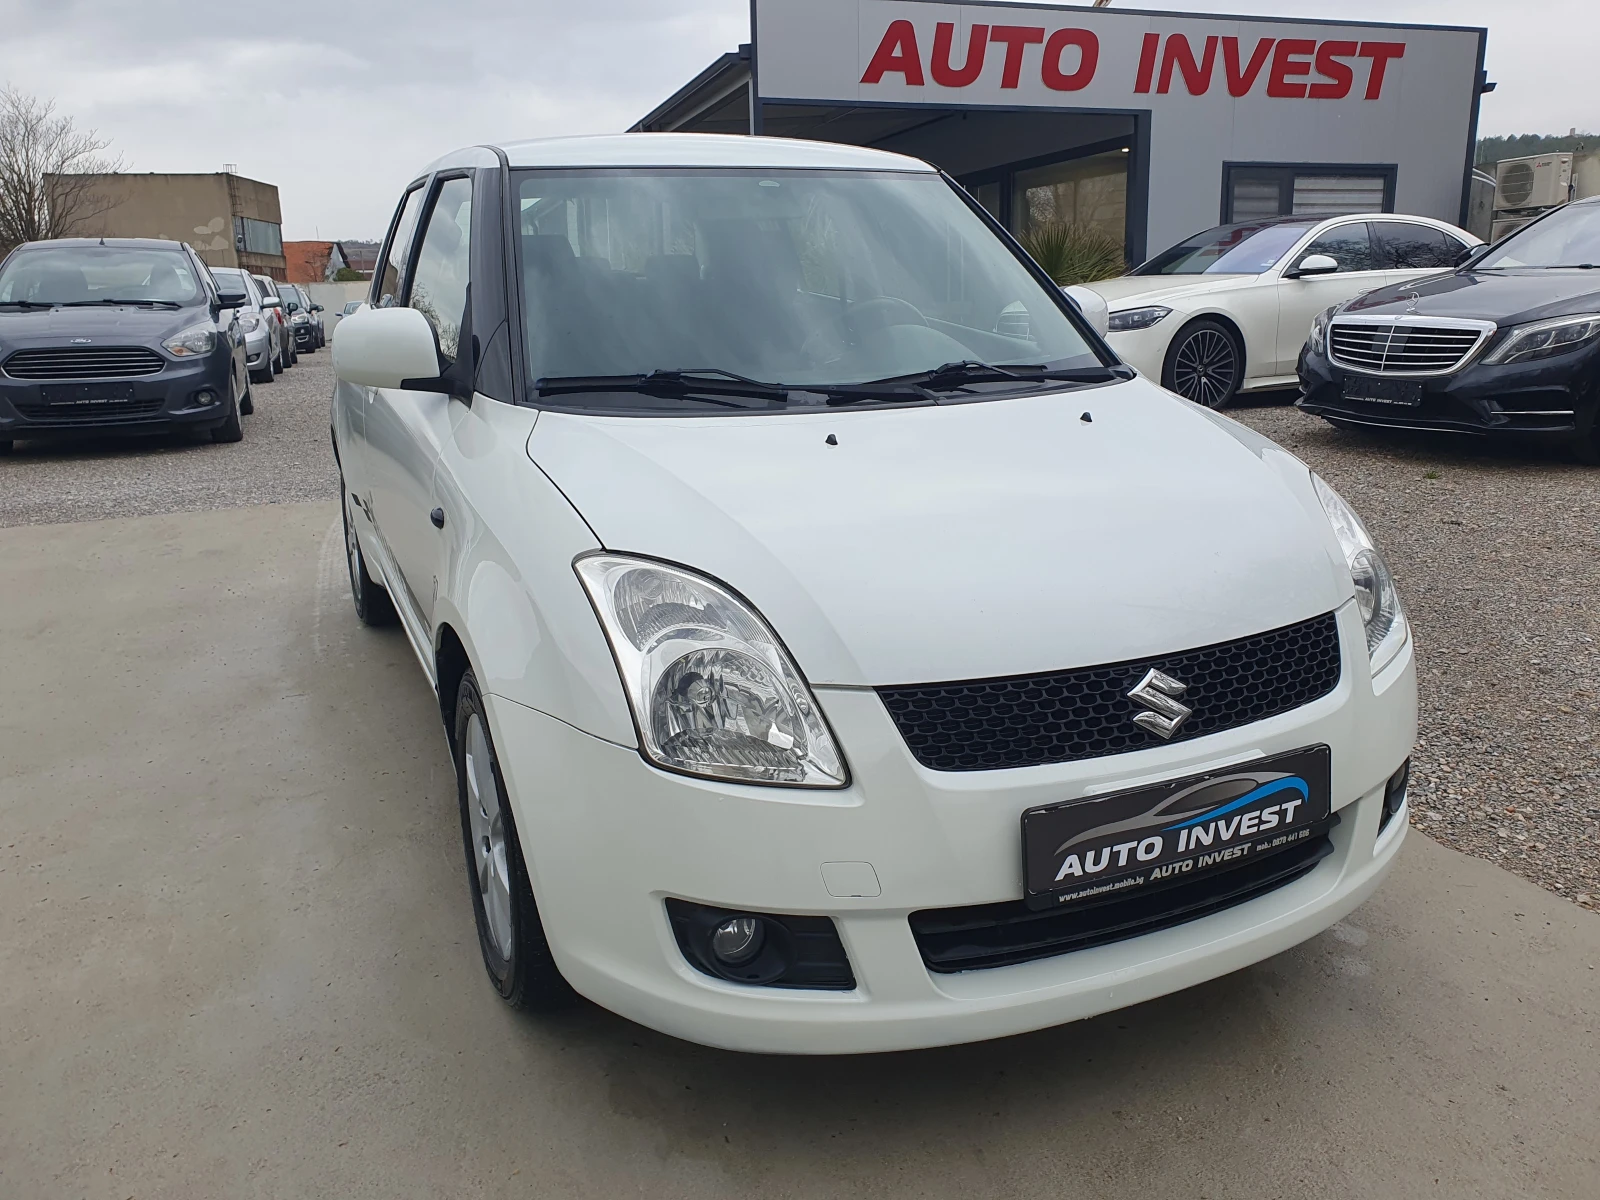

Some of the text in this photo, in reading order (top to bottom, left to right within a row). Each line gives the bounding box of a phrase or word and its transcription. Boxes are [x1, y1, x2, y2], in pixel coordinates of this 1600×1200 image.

[860, 20, 1406, 100] AUTO INVEST
[1054, 799, 1303, 881] AUTO INVEST
[1150, 859, 1194, 881] AUTO
[1198, 843, 1251, 868] INVEST
